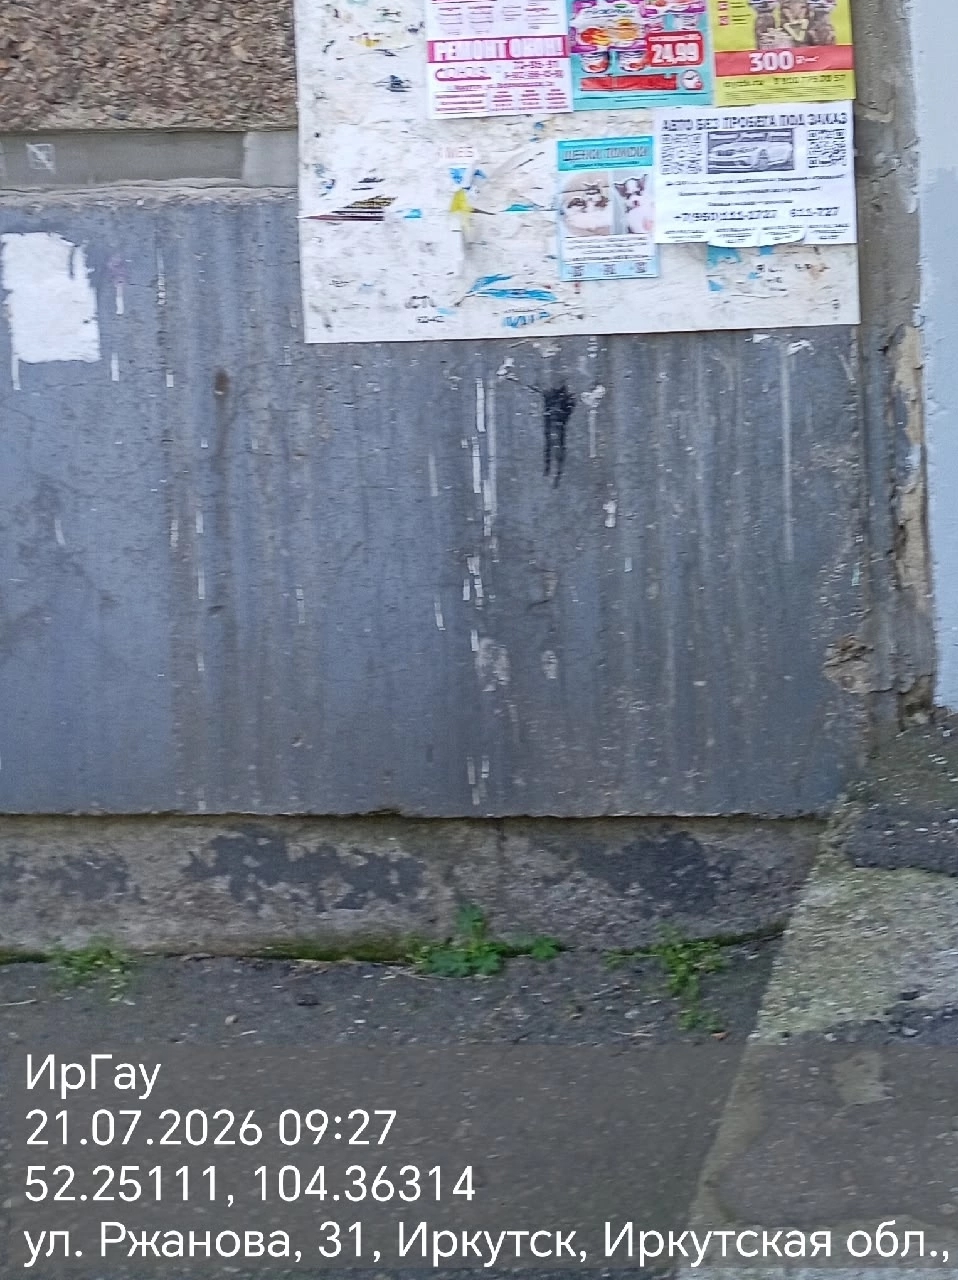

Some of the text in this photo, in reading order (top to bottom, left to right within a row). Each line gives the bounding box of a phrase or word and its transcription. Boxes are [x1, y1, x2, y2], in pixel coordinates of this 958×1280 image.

[650, 42, 700, 65] 24,99
[749, 51, 795, 72] 300
[661, 112, 848, 132] АВТО БЕЗ ПРОБЕГА ПОД ЗАКАЗ
